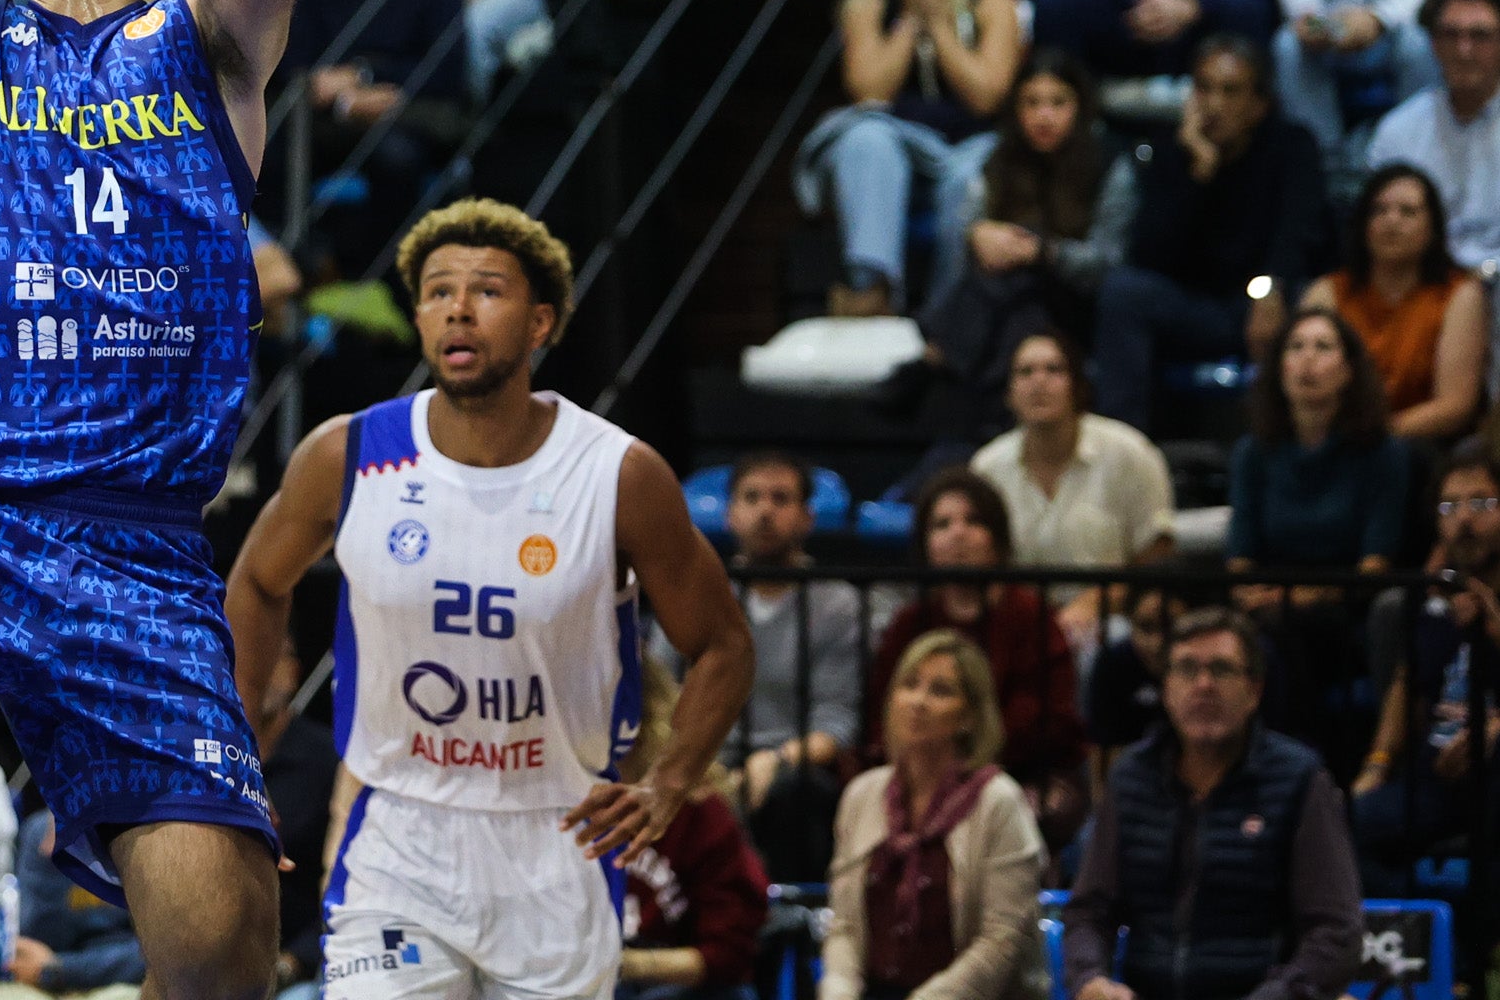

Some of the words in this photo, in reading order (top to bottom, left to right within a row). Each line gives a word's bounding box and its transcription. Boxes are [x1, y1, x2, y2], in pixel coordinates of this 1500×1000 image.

[64, 167, 129, 235] 14
[93, 313, 197, 344] Asturias
[149, 344, 193, 359] natural
[433, 579, 516, 640] 26
[477, 675, 545, 723] HLA
[410, 731, 545, 771] ALICANTE
[326, 953, 399, 983] suma
